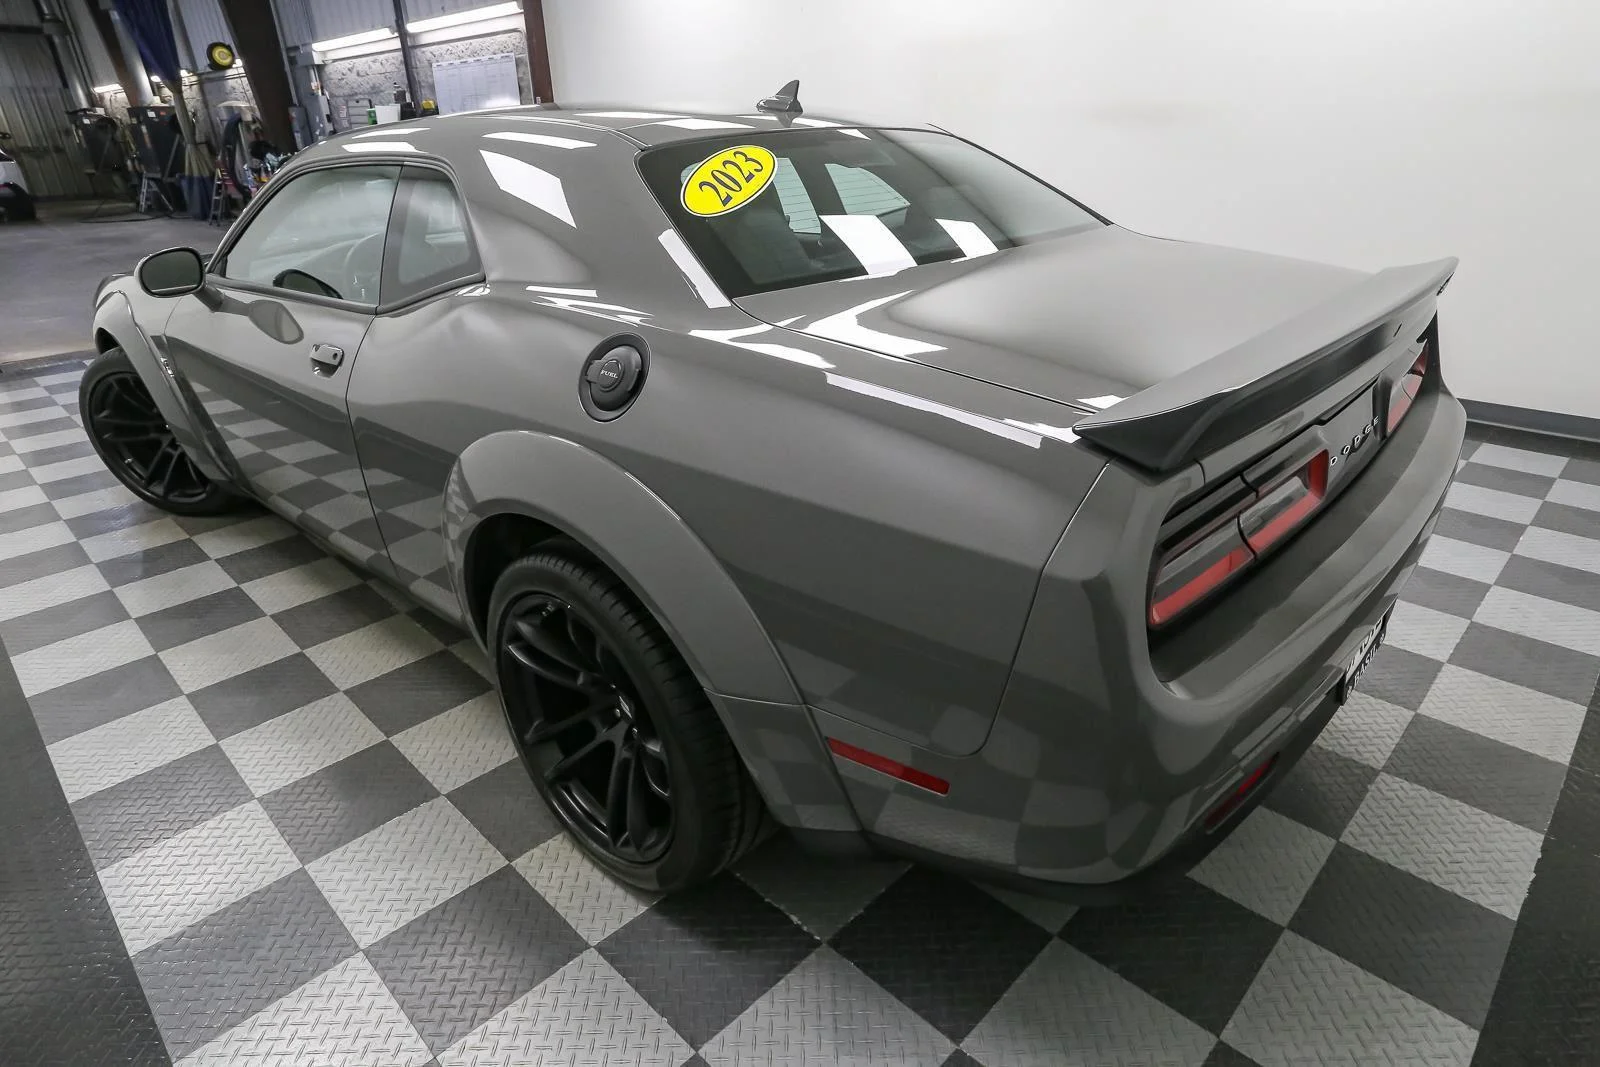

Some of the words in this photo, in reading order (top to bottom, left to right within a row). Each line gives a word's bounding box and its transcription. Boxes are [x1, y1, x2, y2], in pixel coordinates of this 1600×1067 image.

[699, 151, 763, 207] 2023
[600, 369, 618, 378] FUEL
[1330, 416, 1379, 466] DODGE
